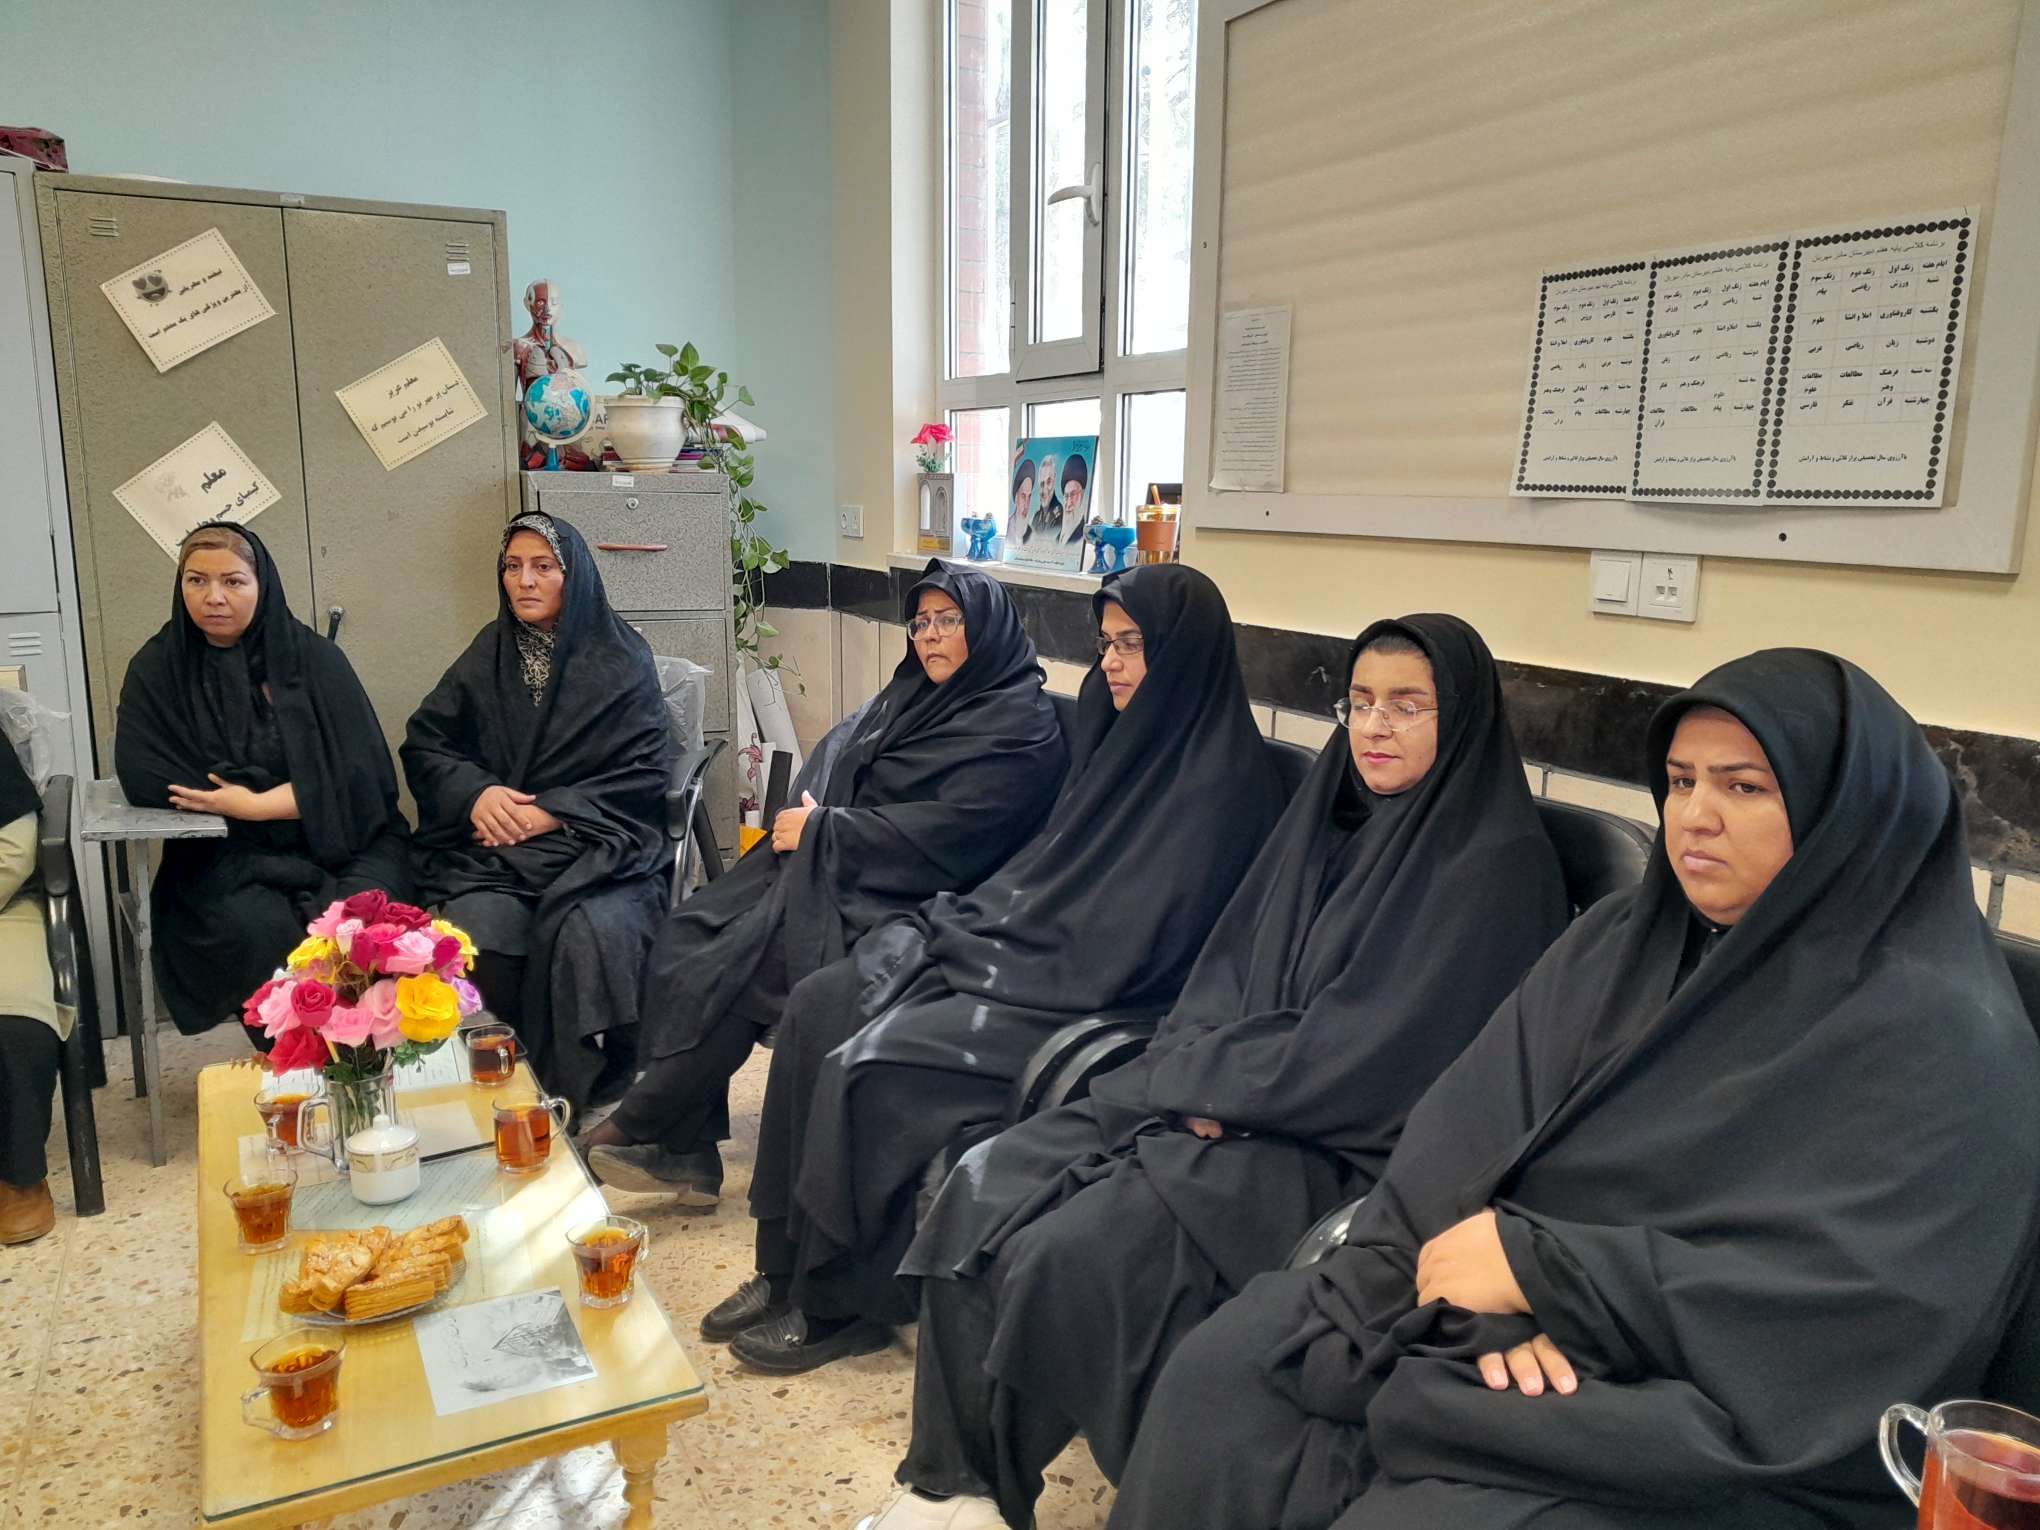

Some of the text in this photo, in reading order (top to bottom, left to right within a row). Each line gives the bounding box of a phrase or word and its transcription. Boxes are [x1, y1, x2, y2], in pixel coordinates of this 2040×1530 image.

[1889, 264, 1913, 274] زنگ اول
[1852, 283, 1871, 293] ریاضی
[1890, 280, 1908, 288] ورزش
[1845, 342, 1864, 351] ریاضی
[1886, 339, 1899, 347] زبان
[389, 377, 418, 398] معلم عزیز
[1805, 386, 1816, 394] علوم
[1800, 401, 1817, 410] فارسی
[1877, 397, 1893, 406] قرآن
[201, 469, 226, 493] معلم
